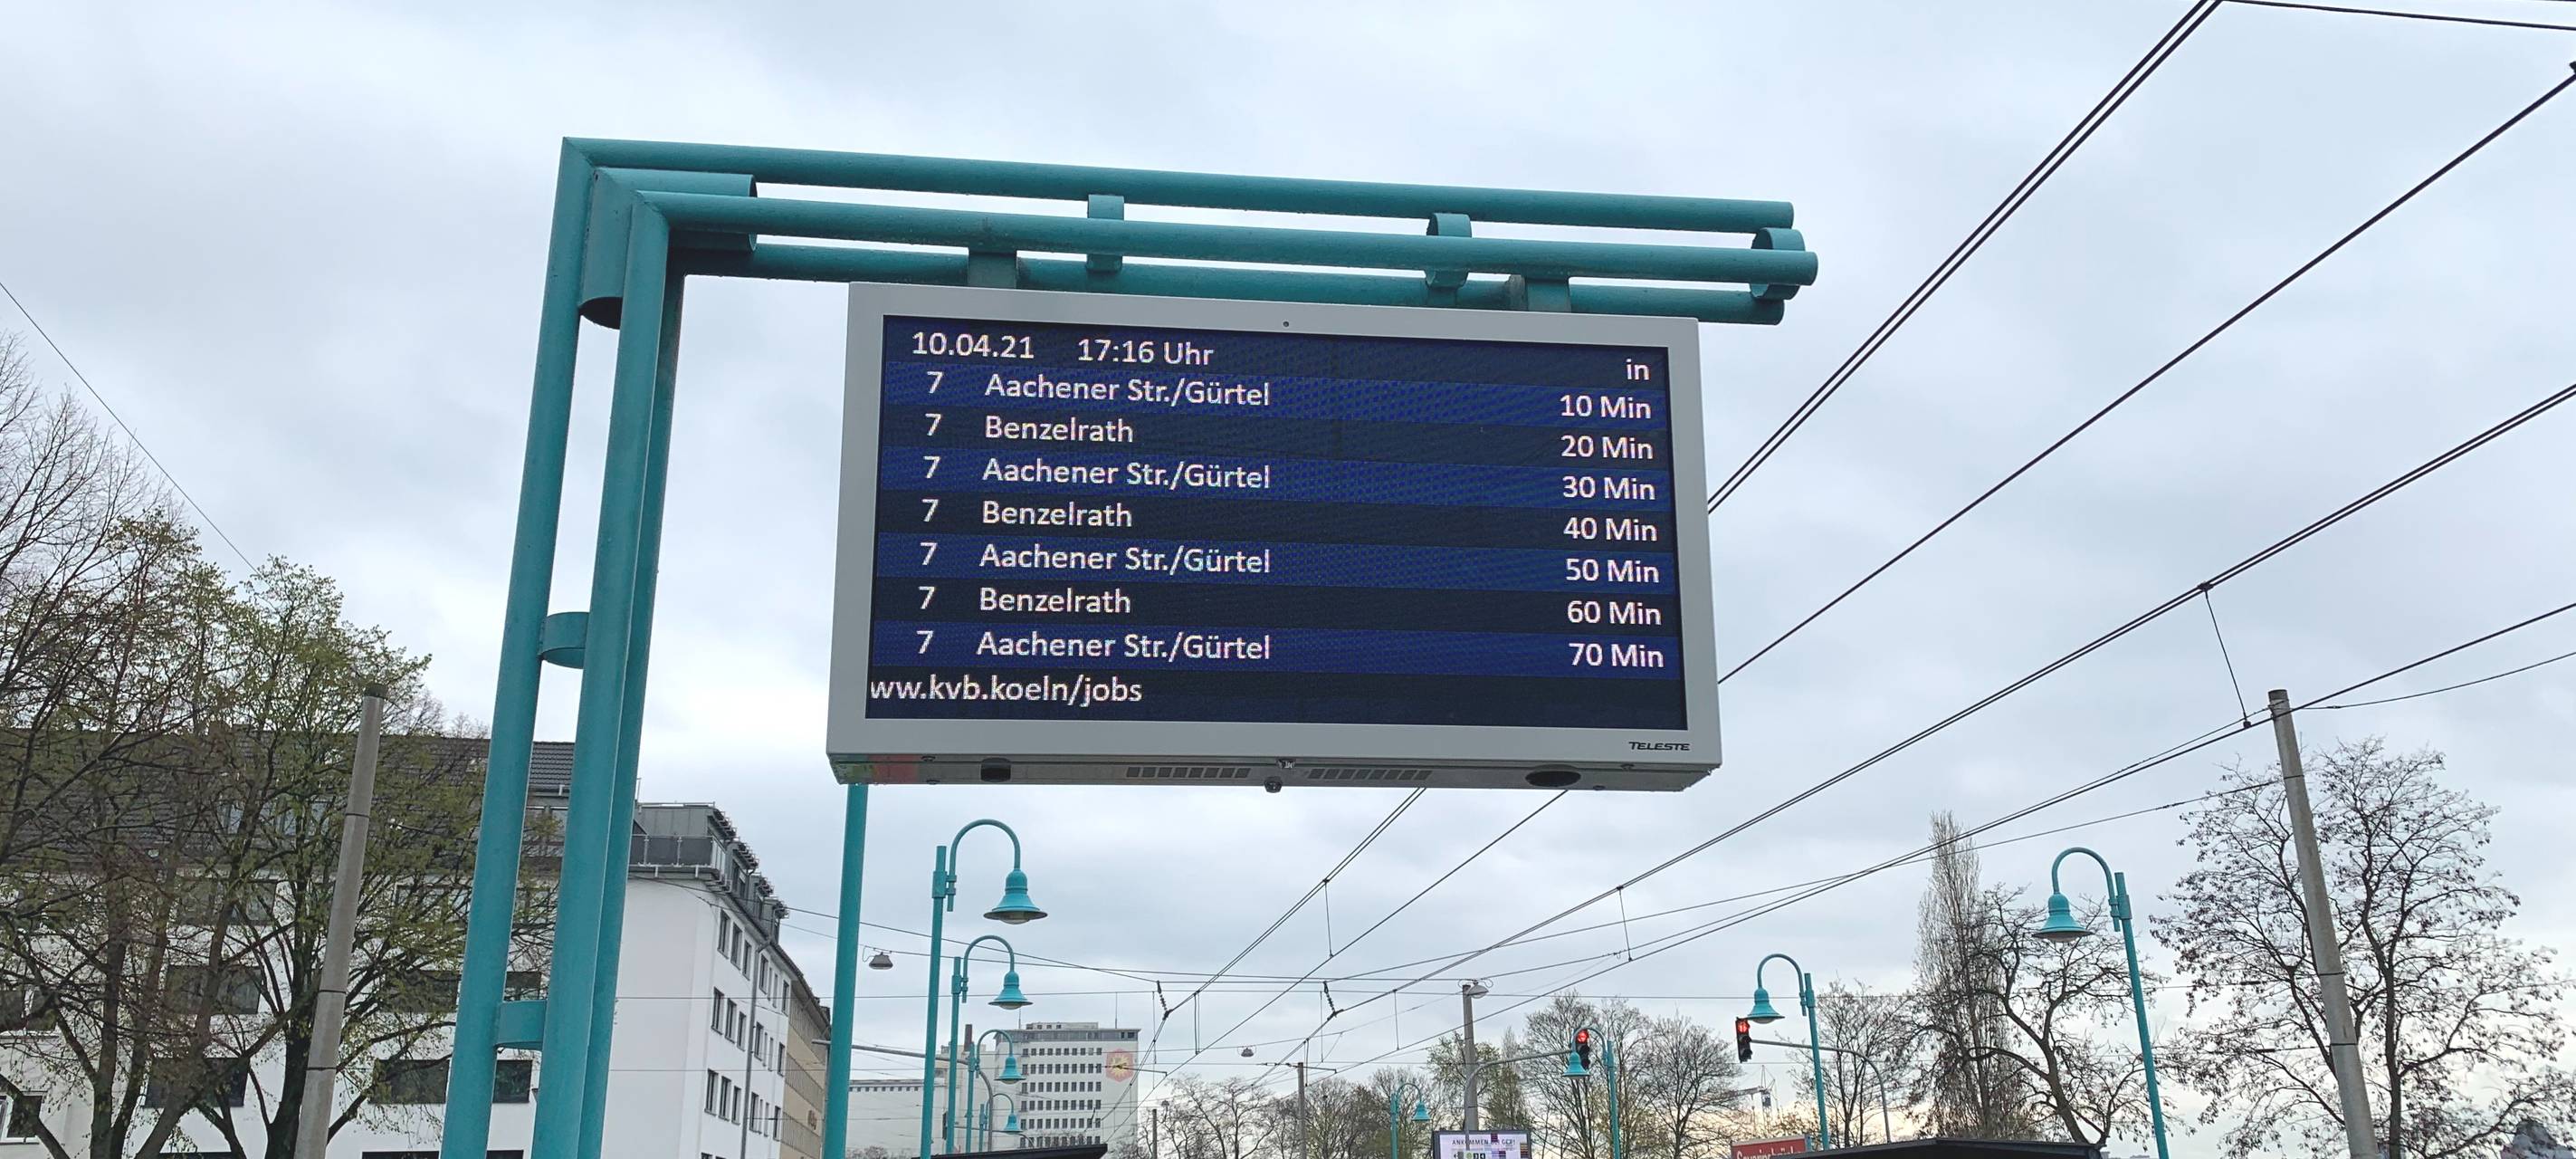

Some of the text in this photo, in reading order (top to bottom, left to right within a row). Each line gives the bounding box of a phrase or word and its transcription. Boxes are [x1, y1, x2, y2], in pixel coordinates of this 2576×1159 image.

[913, 332, 1648, 379] 10.04.21 17:16 Uhr in
[928, 371, 1650, 418] 7 Aachener Str./Gürtel 10 Min
[926, 414, 1653, 459] 7 Benzelrath 20 Min
[924, 456, 1655, 500] 7 Aachener Str./Gürtel 30 Min
[922, 499, 1656, 541] 7 Benzelrath 40 Min
[921, 542, 1658, 582] 7 Aachener Str./Gürtel 50 Min
[920, 587, 1661, 625] 7 Benzelrath 60 Min
[917, 631, 1663, 667] 7 Aachener Str./Gürtel 70 Min
[871, 675, 1141, 707] ww.kvb.koeln/jobs
[1628, 742, 1691, 752] TELESTE
